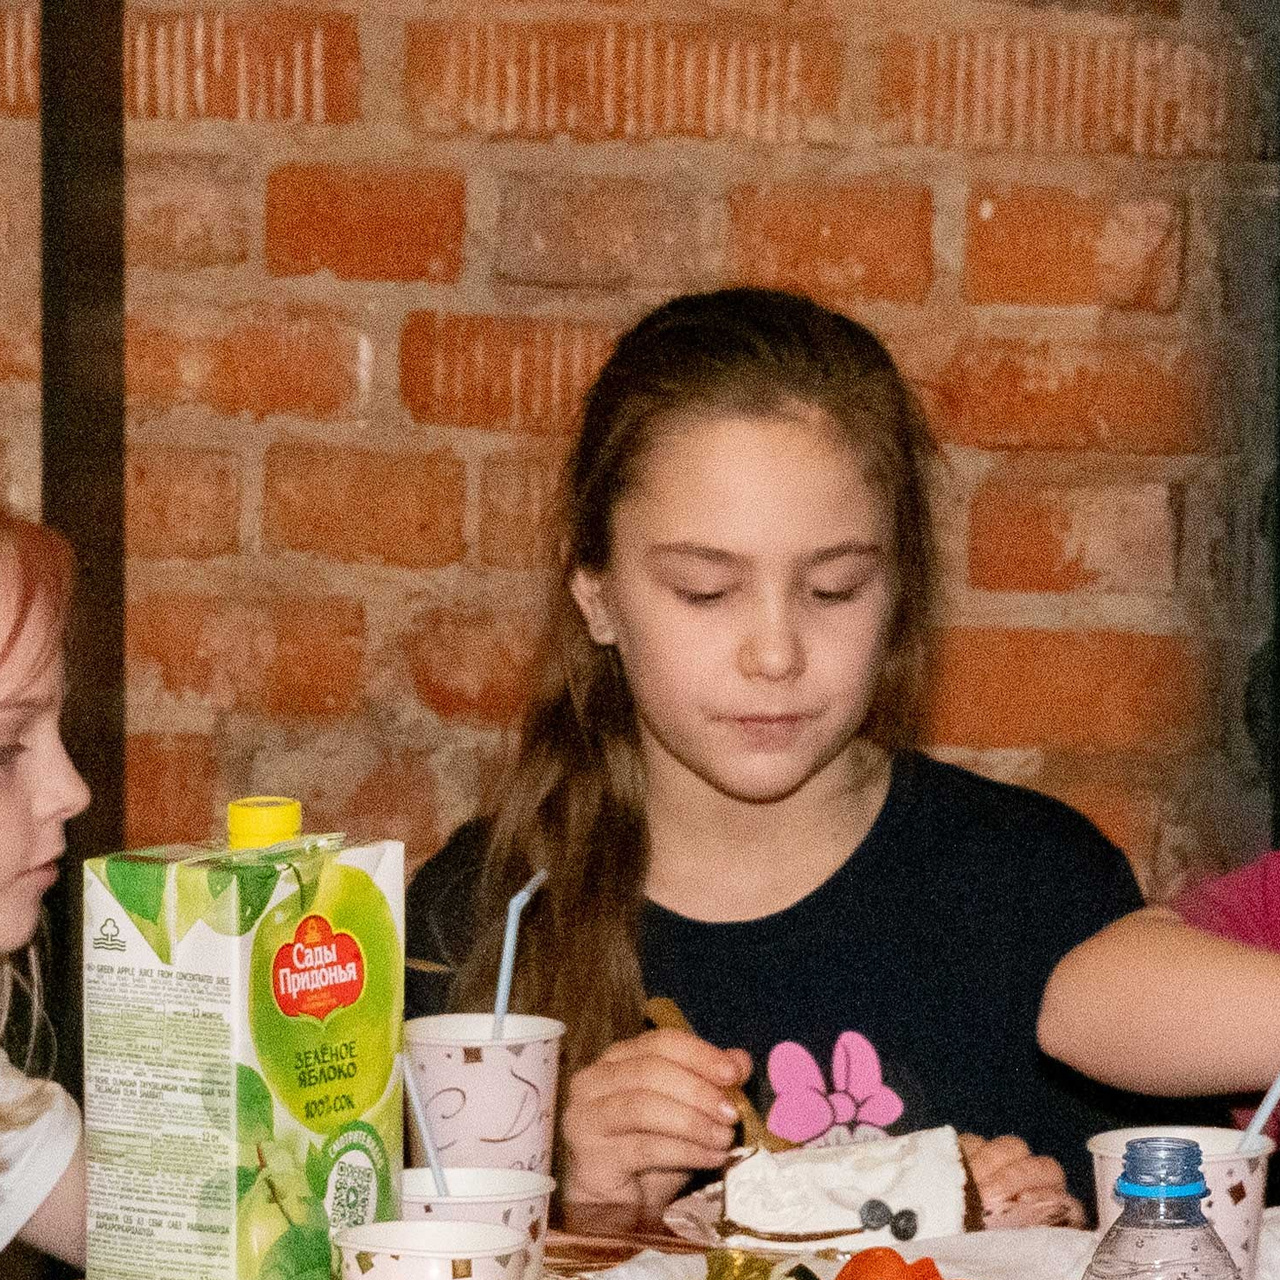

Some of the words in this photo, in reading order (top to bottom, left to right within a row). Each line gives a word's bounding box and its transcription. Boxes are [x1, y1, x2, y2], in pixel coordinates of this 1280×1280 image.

[292, 943, 338, 969] Сады
[117, 966, 135, 976] APPLE
[278, 961, 358, 999] Придонья
[295, 1041, 358, 1070] ЗЕЛЁНОЕ
[299, 1062, 358, 1088] ЯБЛОКО
